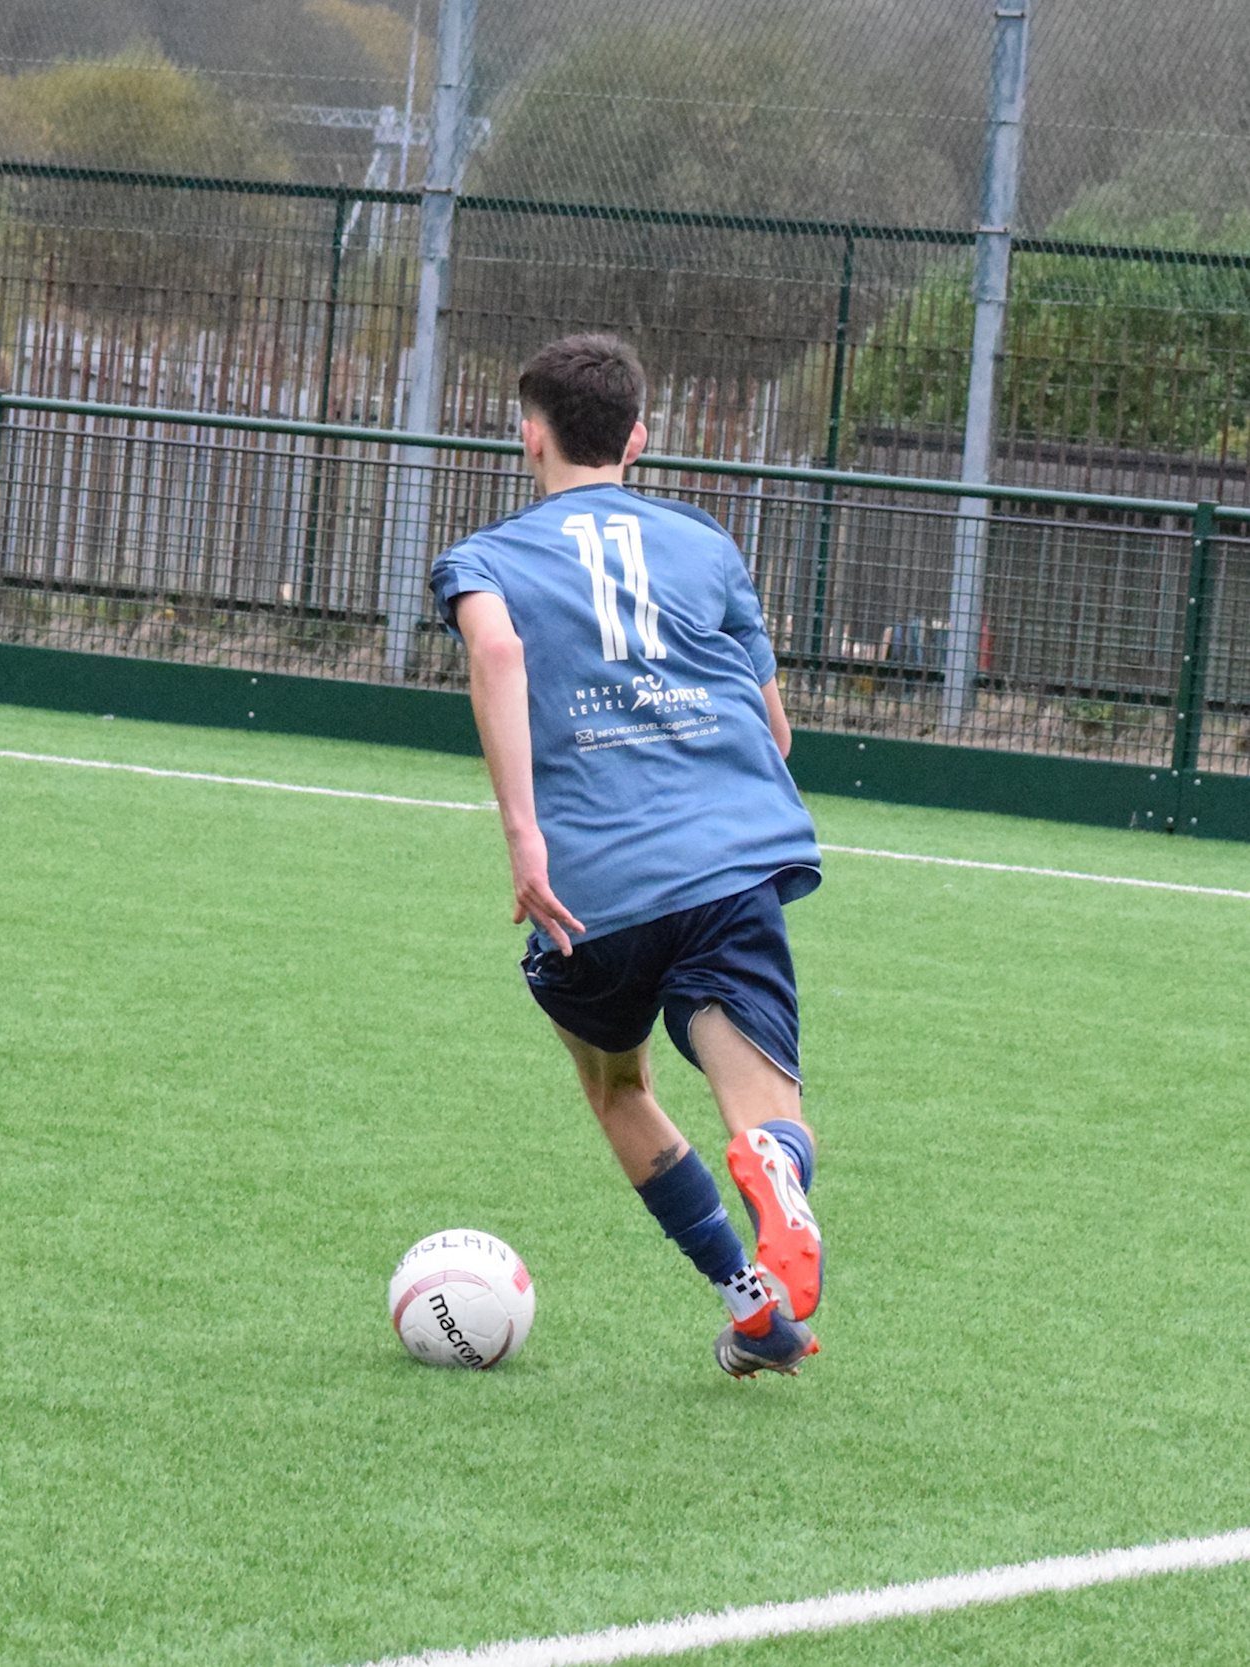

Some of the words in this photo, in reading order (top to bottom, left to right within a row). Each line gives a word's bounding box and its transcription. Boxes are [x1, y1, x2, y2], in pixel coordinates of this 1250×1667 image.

[560, 513, 667, 662] 11
[576, 684, 623, 700] NEXT
[569, 699, 625, 717] LEVEL
[654, 700, 713, 715] COACHING
[428, 1293, 484, 1368] macron
